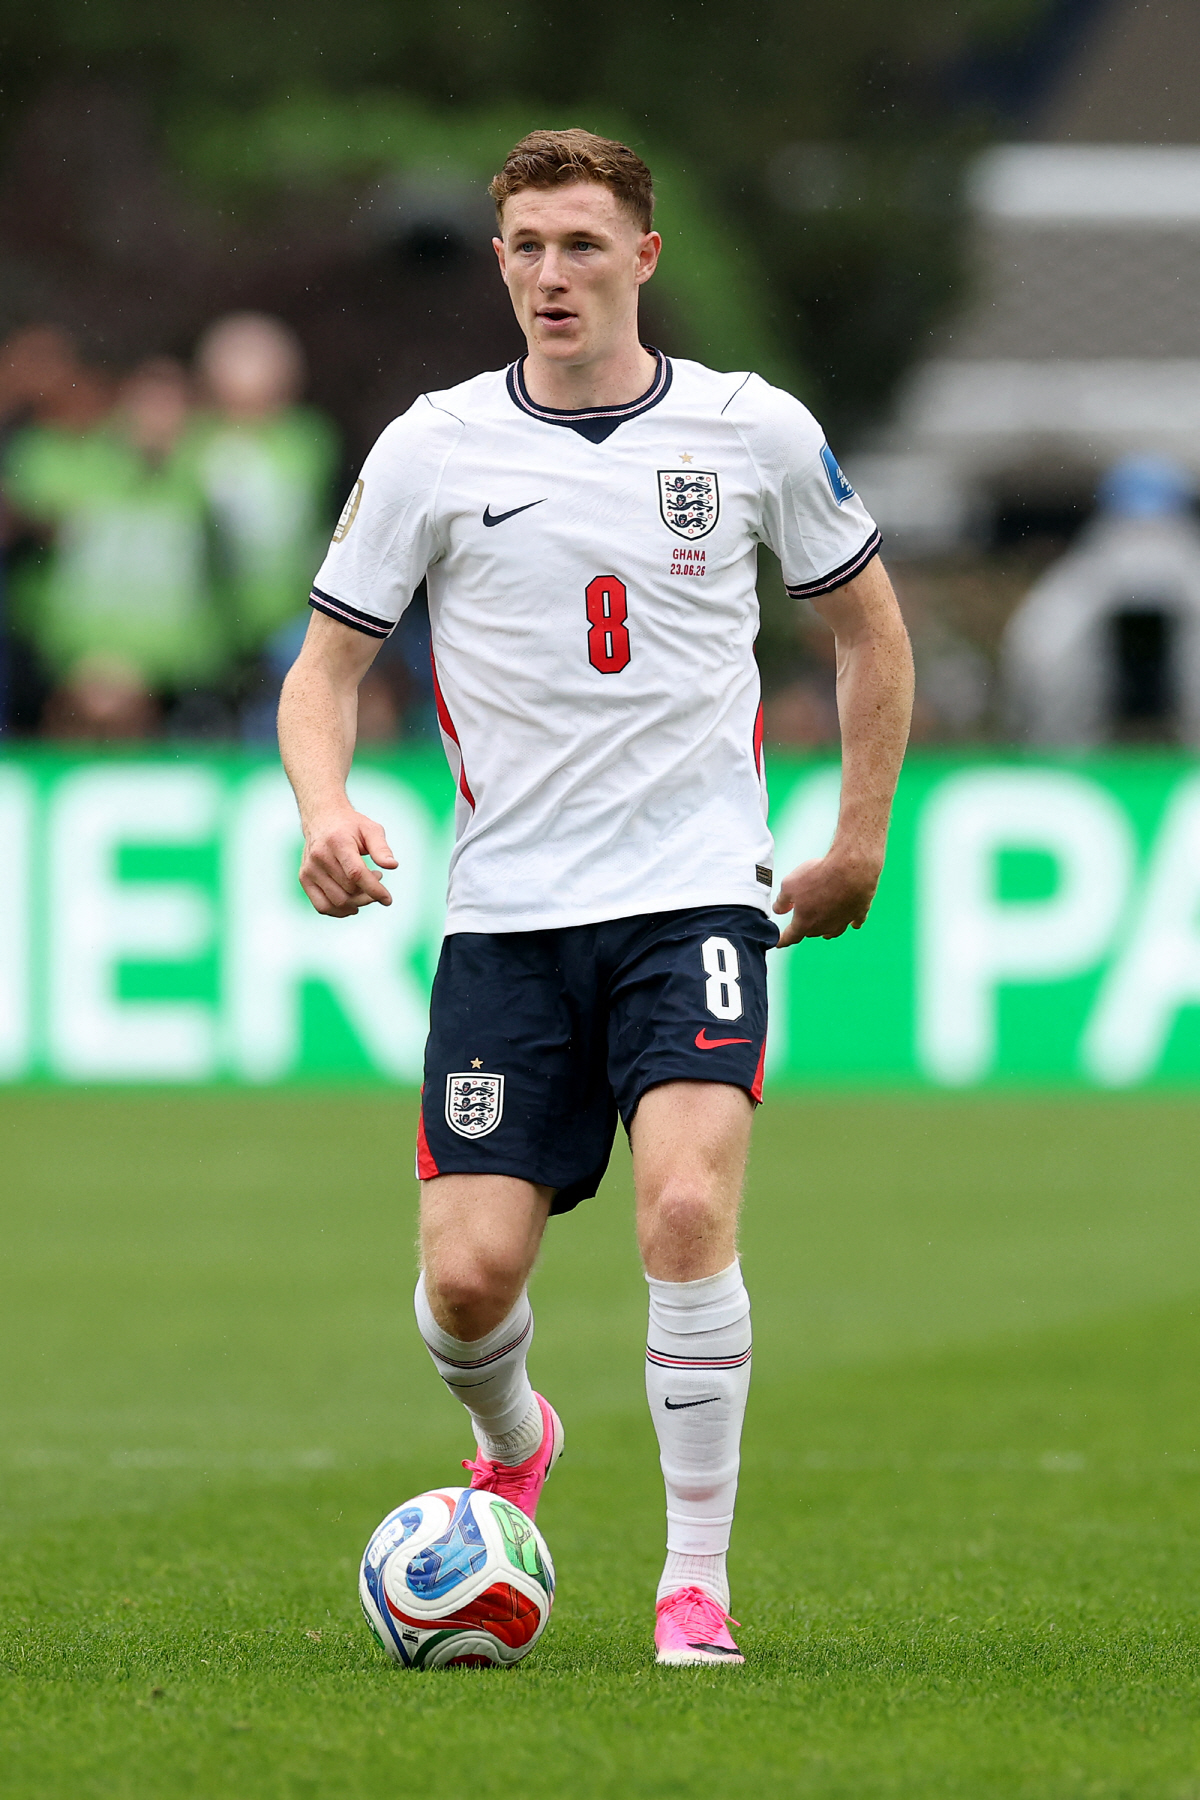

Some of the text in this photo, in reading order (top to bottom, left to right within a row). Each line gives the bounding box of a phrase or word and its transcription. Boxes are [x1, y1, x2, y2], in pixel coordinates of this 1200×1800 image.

[670, 563, 706, 577] 23.06.26
[672, 548, 706, 562] GHANA
[585, 574, 631, 674] 8
[701, 935, 744, 1022] 8
